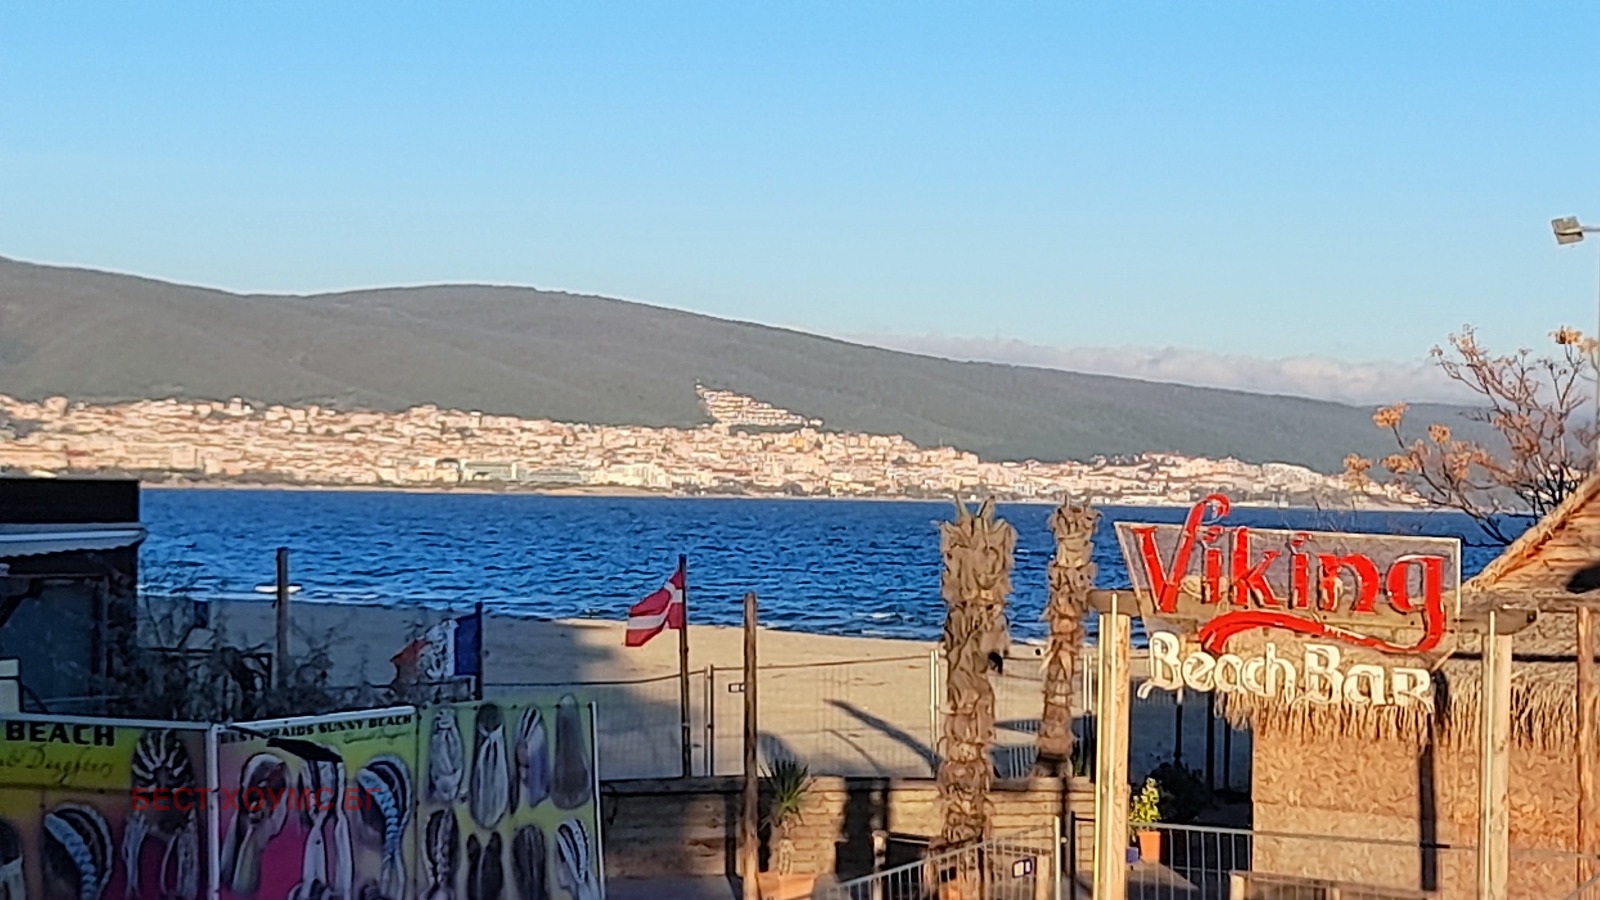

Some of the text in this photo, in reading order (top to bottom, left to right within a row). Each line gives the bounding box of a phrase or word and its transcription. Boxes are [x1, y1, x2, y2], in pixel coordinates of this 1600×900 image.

[1131, 493, 1446, 653] Viking
[1137, 630, 1296, 705] Beach
[6, 720, 115, 747] BEACH
[368, 714, 412, 729] BEACH
